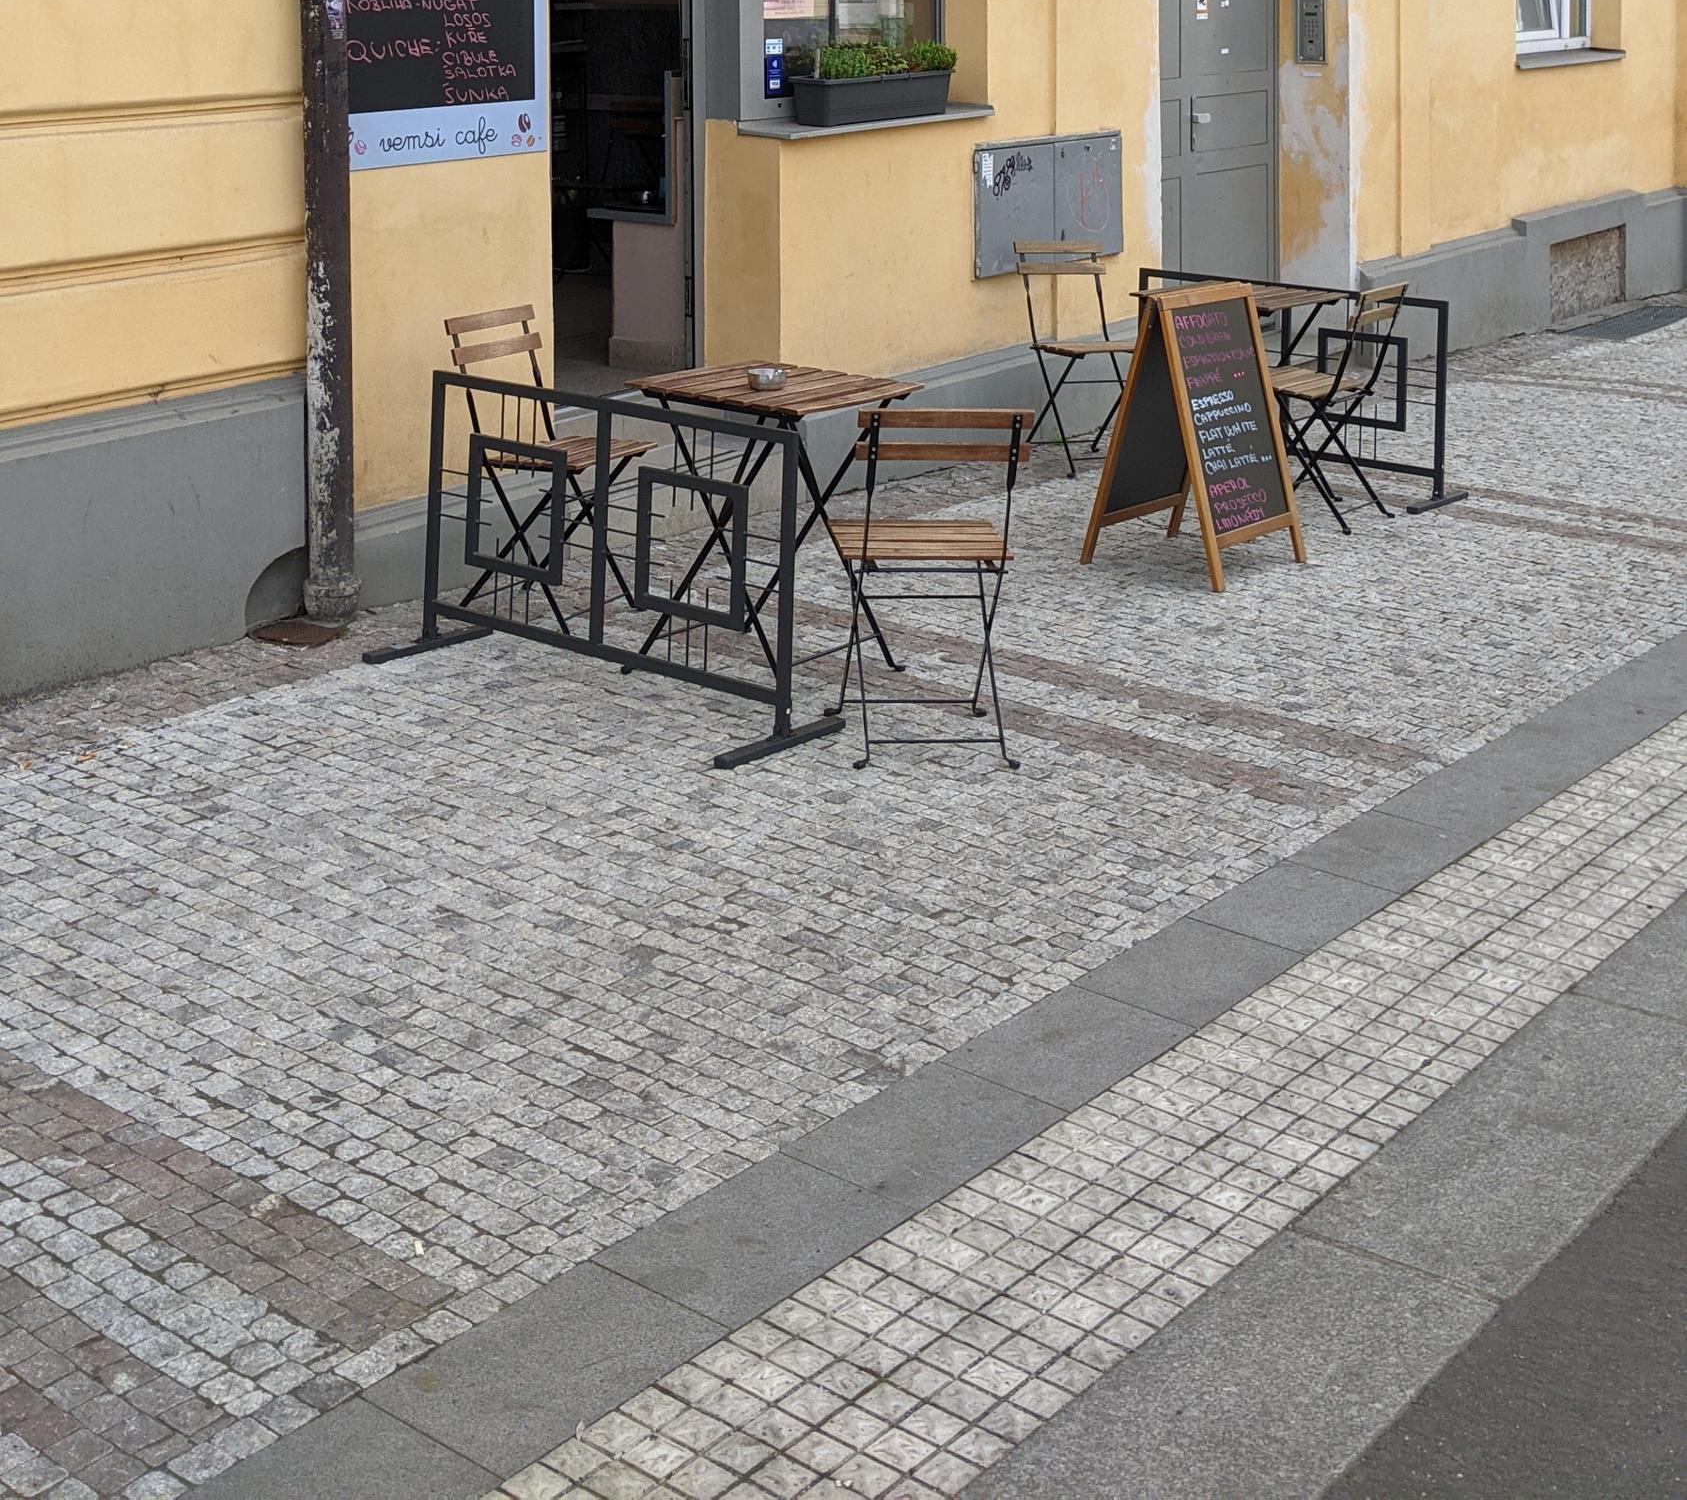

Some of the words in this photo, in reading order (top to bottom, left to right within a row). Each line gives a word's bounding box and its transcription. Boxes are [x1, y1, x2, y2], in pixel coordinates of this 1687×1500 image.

[444, 12, 492, 28] LOSOS
[446, 28, 488, 48] KUŘE
[346, 38, 441, 64] QUICHE:
[442, 50, 499, 66] CIBULE
[442, 64, 516, 80] ŠALOTKA
[442, 82, 510, 104] ŠUNKA
[379, 128, 446, 153] vemsi
[455, 116, 498, 154] cafe
[1191, 390, 1234, 411] ESPRESSO
[1194, 402, 1252, 426] CAPPUCCINO
[1199, 426, 1224, 444] FLAT
[1224, 420, 1258, 437] WHITE
[1202, 438, 1236, 460] LATTÉ
[1204, 458, 1228, 475] CHAI
[1209, 476, 1252, 498] APEROL
[1214, 489, 1266, 514] PROSECCO
